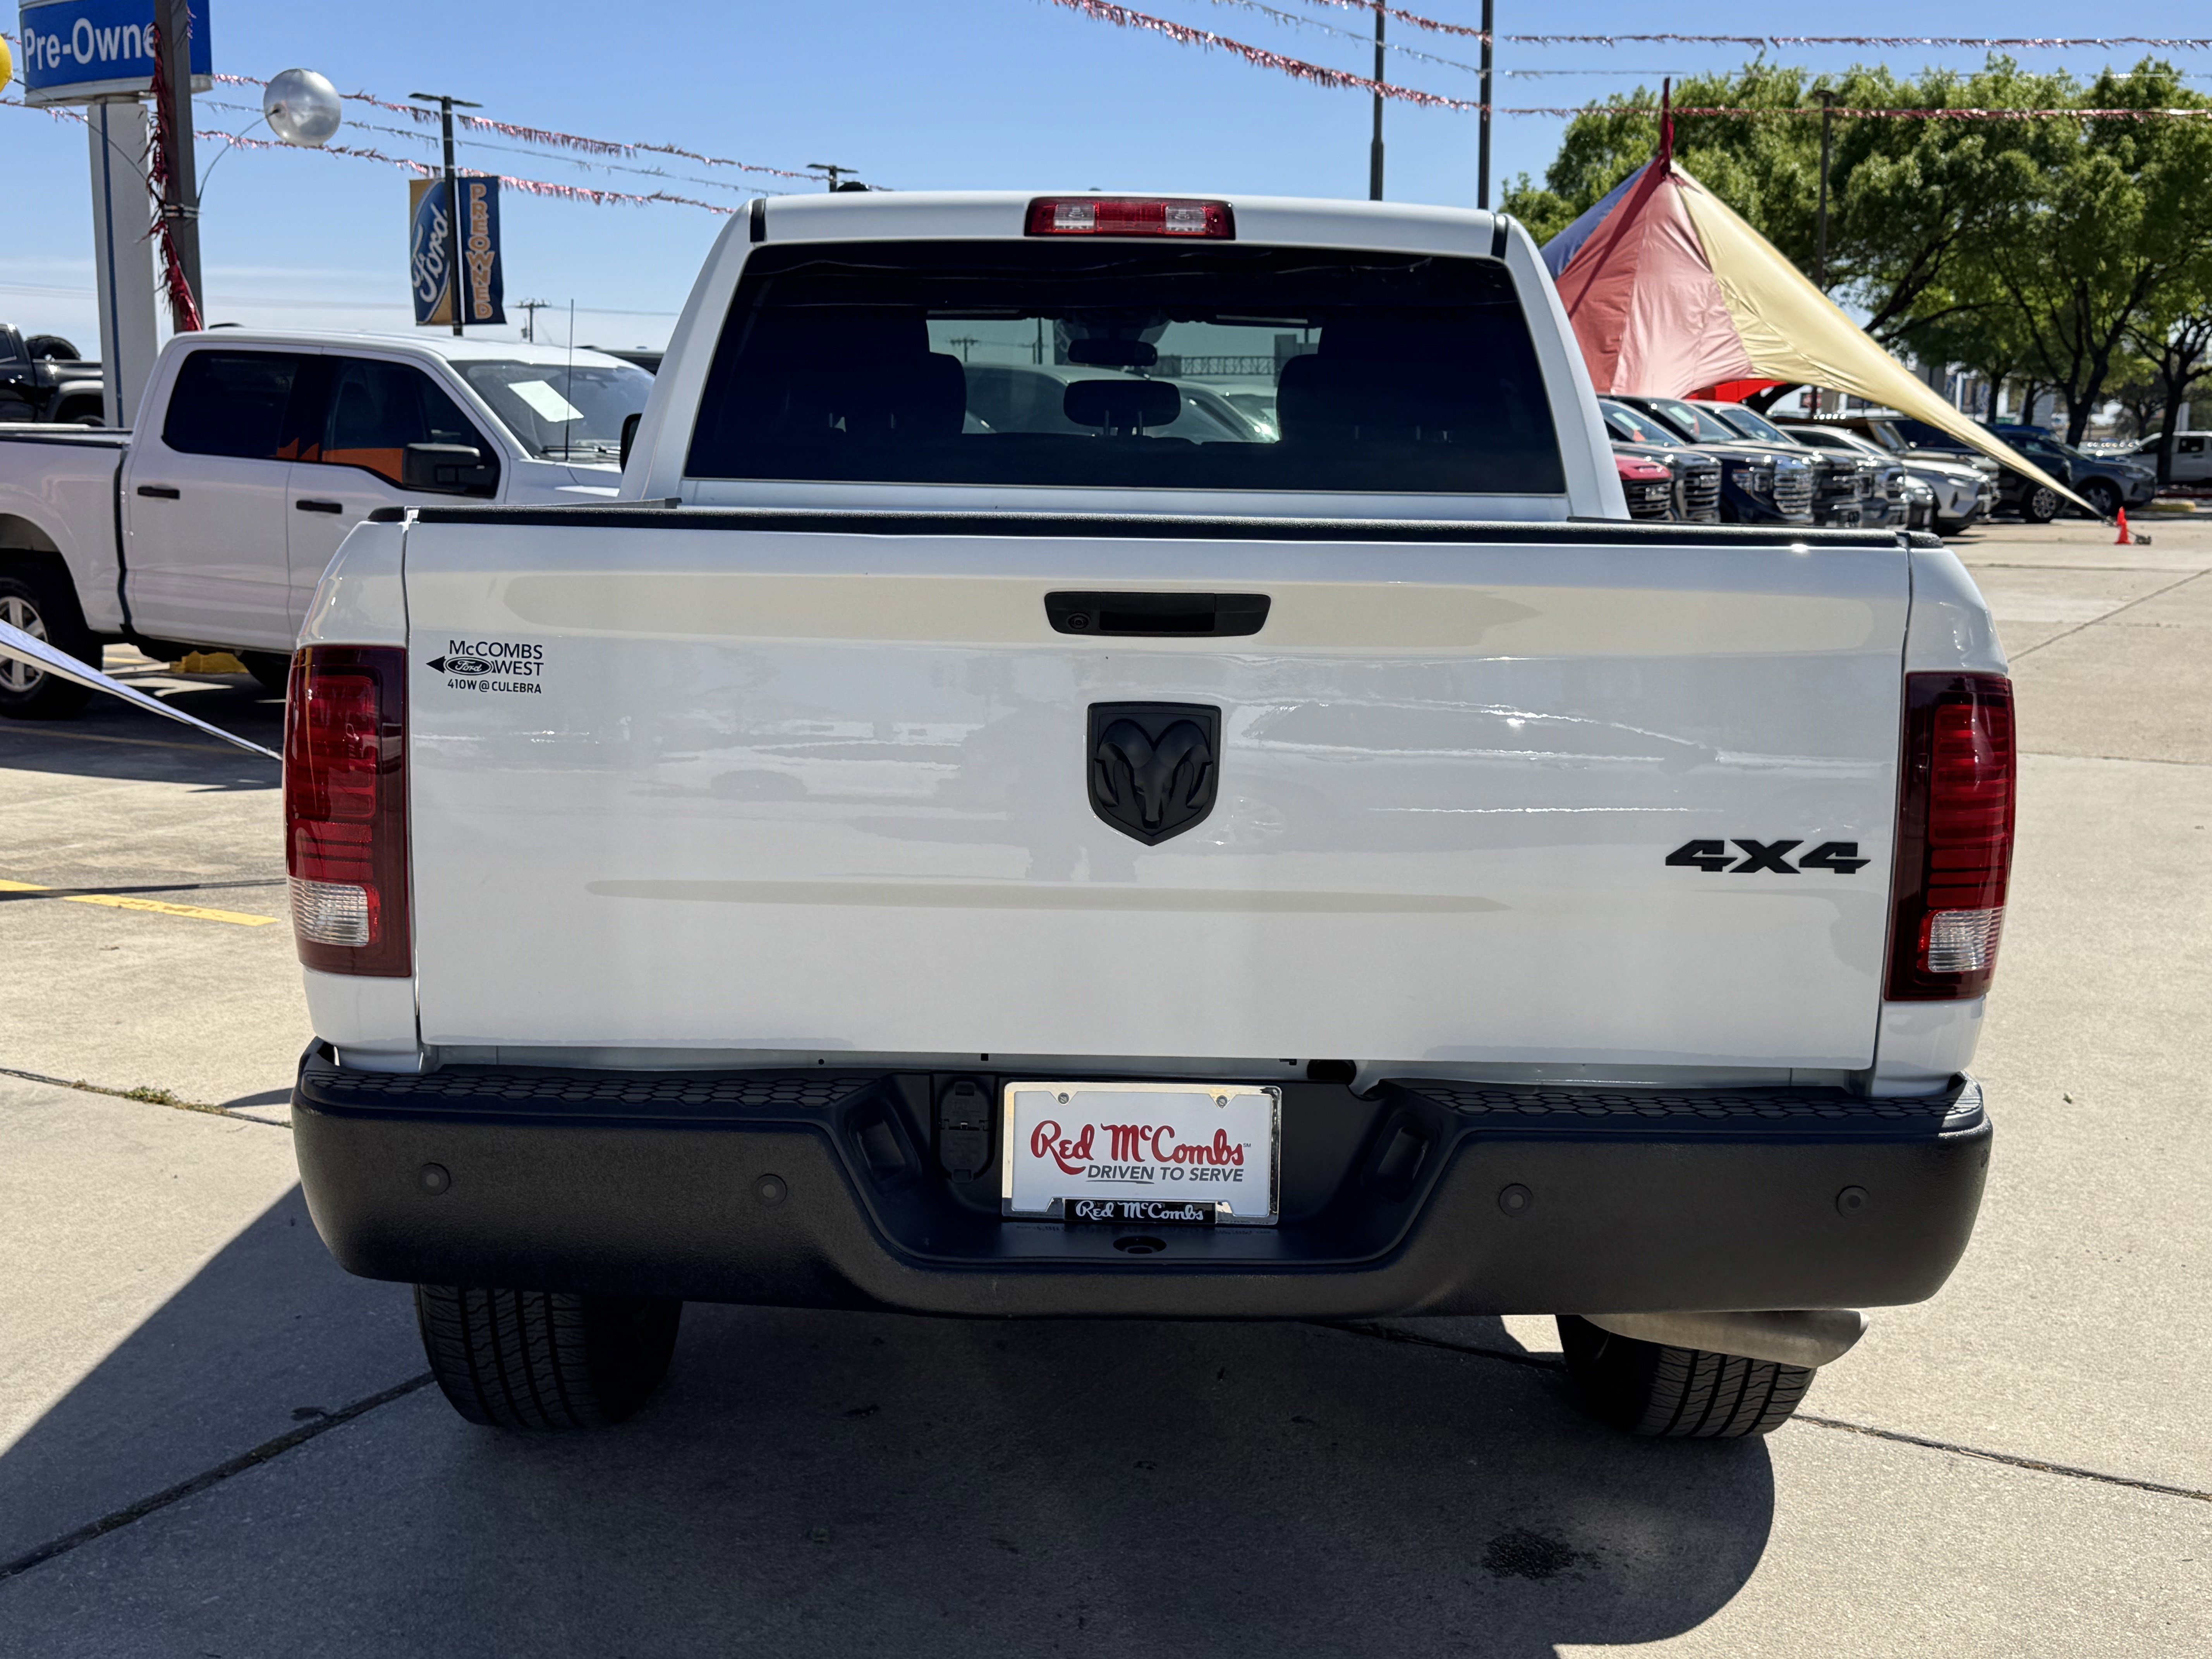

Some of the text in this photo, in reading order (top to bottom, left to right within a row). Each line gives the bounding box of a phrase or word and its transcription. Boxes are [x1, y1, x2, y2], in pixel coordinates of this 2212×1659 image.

[24, 17, 156, 72] Pre-Owne
[411, 202, 448, 302] Ford
[465, 184, 495, 319] PREOWNED
[450, 640, 543, 659] McCOMBS
[455, 660, 482, 672] Ford
[495, 660, 544, 676] WEST
[1030, 1120, 1095, 1175] Red
[1101, 1123, 1244, 1166] McCombs
[1087, 1164, 1245, 1182] DRIVEN TO SERVE
[1075, 1200, 1204, 1220] Red McCombs
